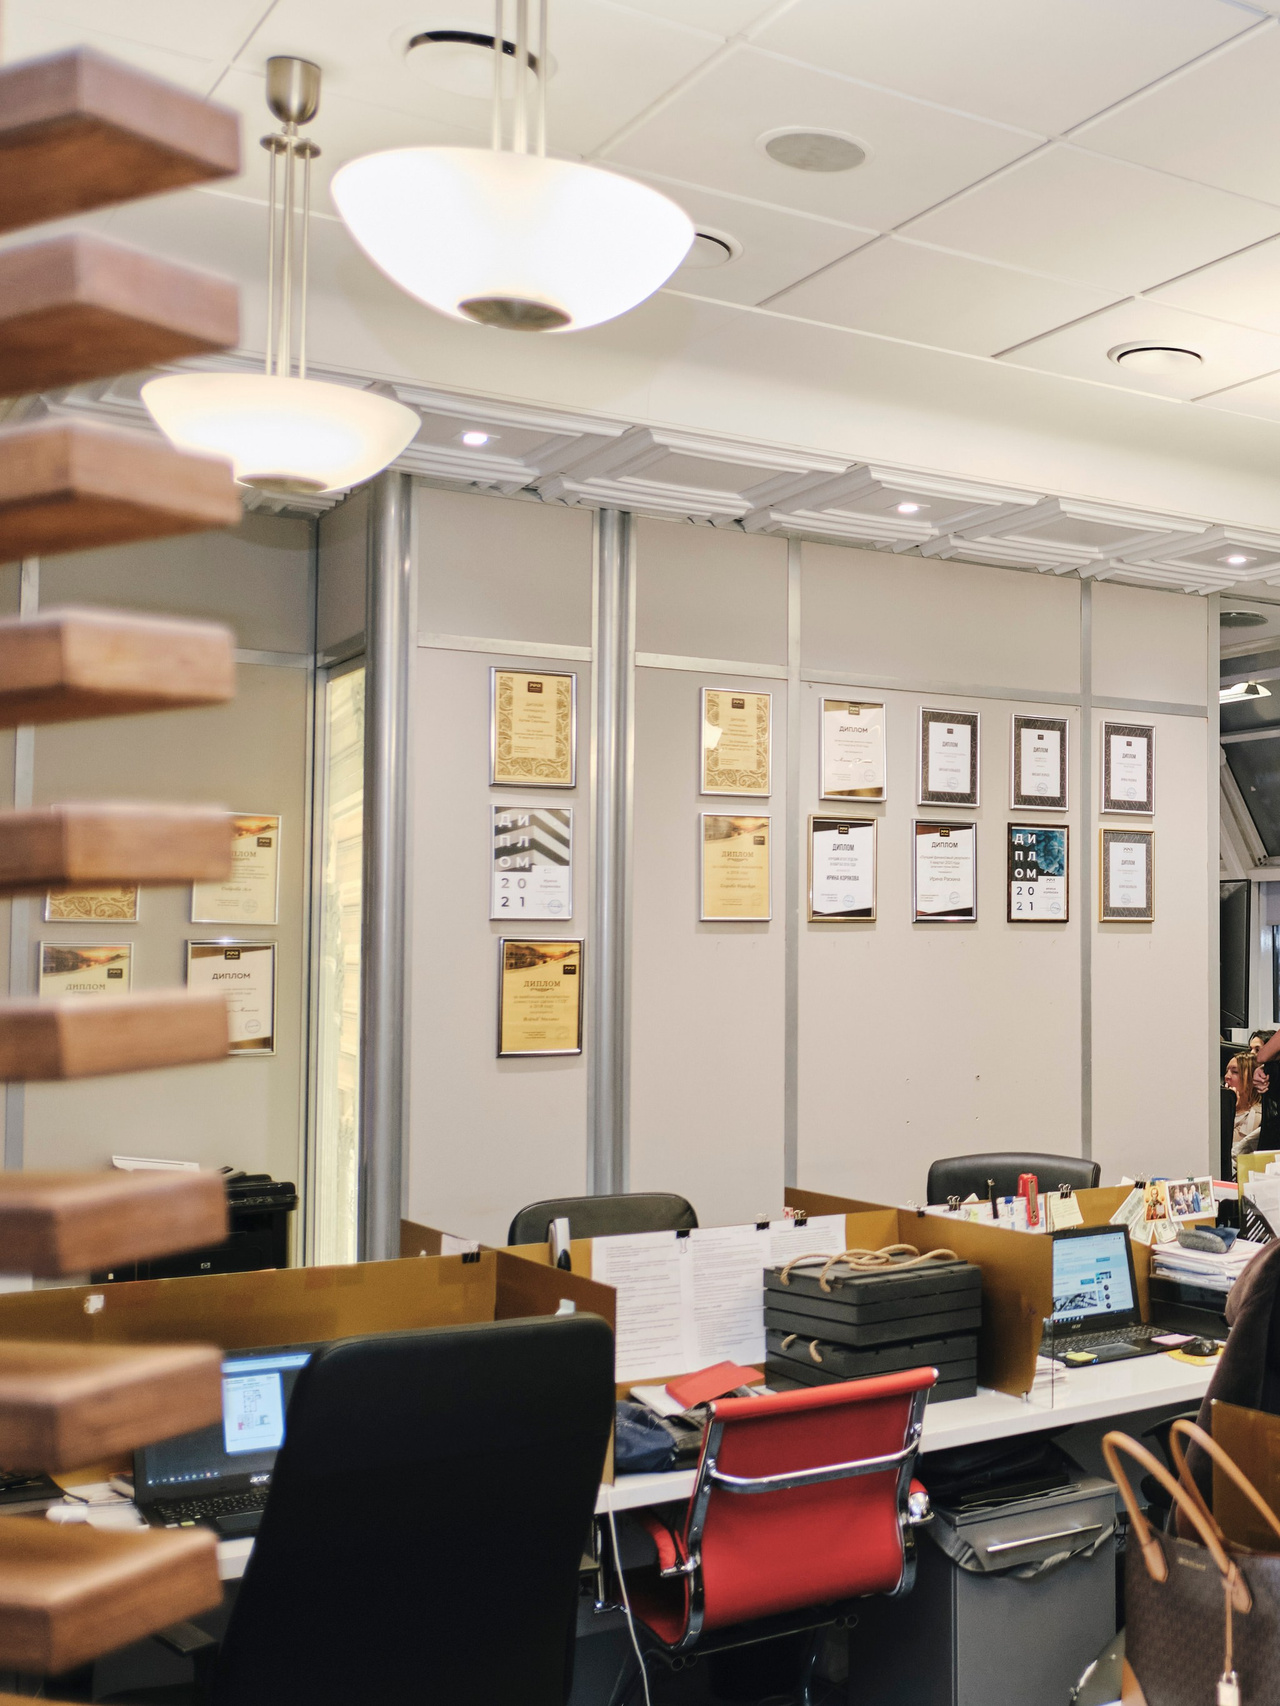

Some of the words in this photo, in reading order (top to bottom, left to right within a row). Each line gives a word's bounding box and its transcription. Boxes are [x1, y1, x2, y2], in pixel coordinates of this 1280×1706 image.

[839, 725, 868, 733] ДИПЛОМ
[1014, 833, 1036, 845] ДИ
[832, 843, 855, 852] ДИПЛОМ
[931, 841, 958, 849] ДИПЛОМ
[1014, 850, 1036, 861] ПЛ
[1014, 868, 1037, 878] ОМ
[1016, 886, 1035, 896] 20
[1016, 901, 1034, 911] 21
[211, 972, 251, 980] ДИПЛОМ
[65, 983, 106, 991] ДИПЛОМ
[523, 980, 561, 988] ДИПЛОМ
[249, 1474, 270, 1483] acer
